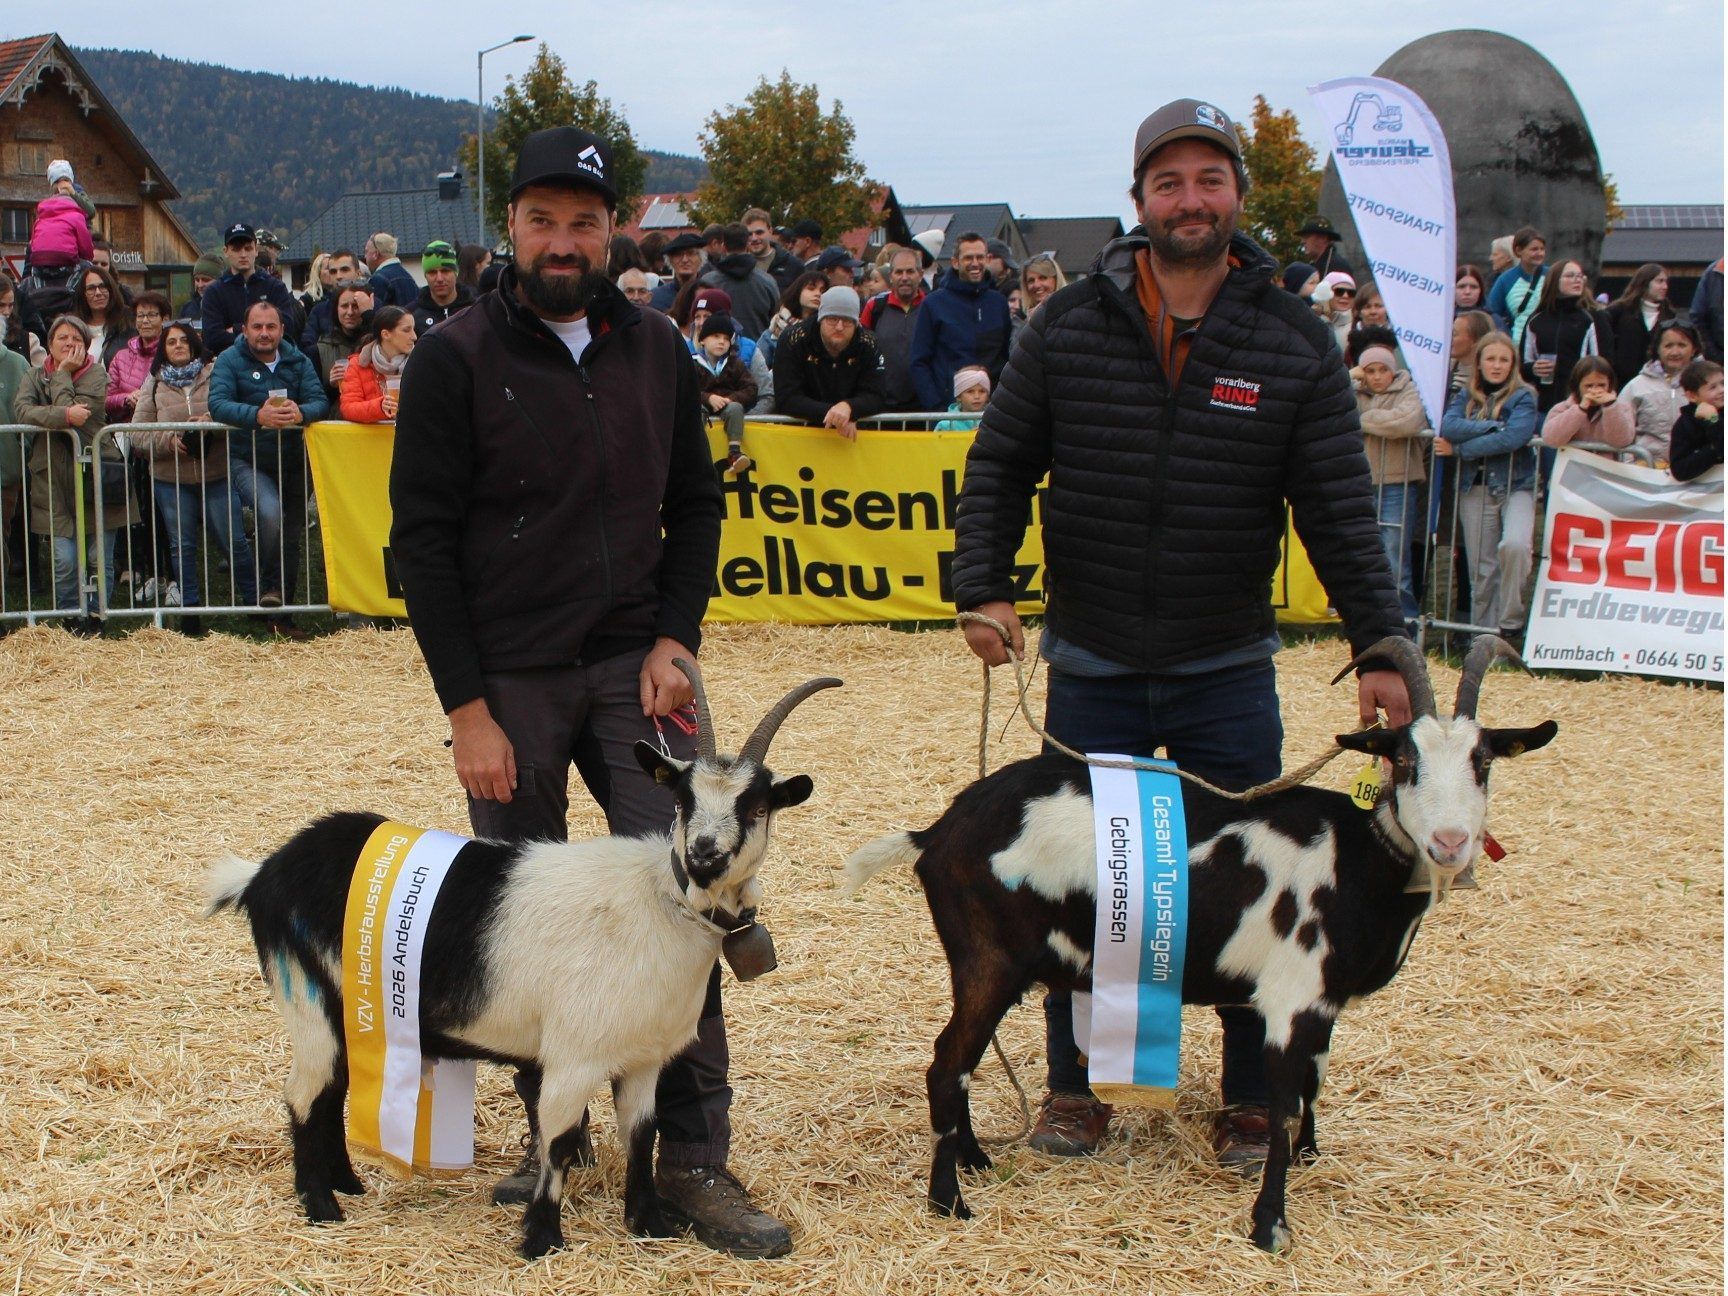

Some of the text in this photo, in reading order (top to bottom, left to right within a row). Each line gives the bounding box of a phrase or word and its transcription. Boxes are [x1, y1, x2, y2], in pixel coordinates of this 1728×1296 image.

[110, 249, 143, 263] loristik
[1212, 384, 1258, 405] RIND
[1215, 376, 1260, 392] vorarlberg
[715, 457, 958, 530] ffeisen
[708, 535, 891, 600] ellau
[1533, 644, 1724, 672] Krumbach 0664 50 5
[356, 834, 408, 986] Herbstausstellung
[1108, 817, 1131, 943] Gebirgsrassen
[1150, 795, 1177, 981] Gesamt Typsiegerin
[392, 865, 430, 1019] 2026 Andelsbuch
[358, 997, 374, 1033] VZV
